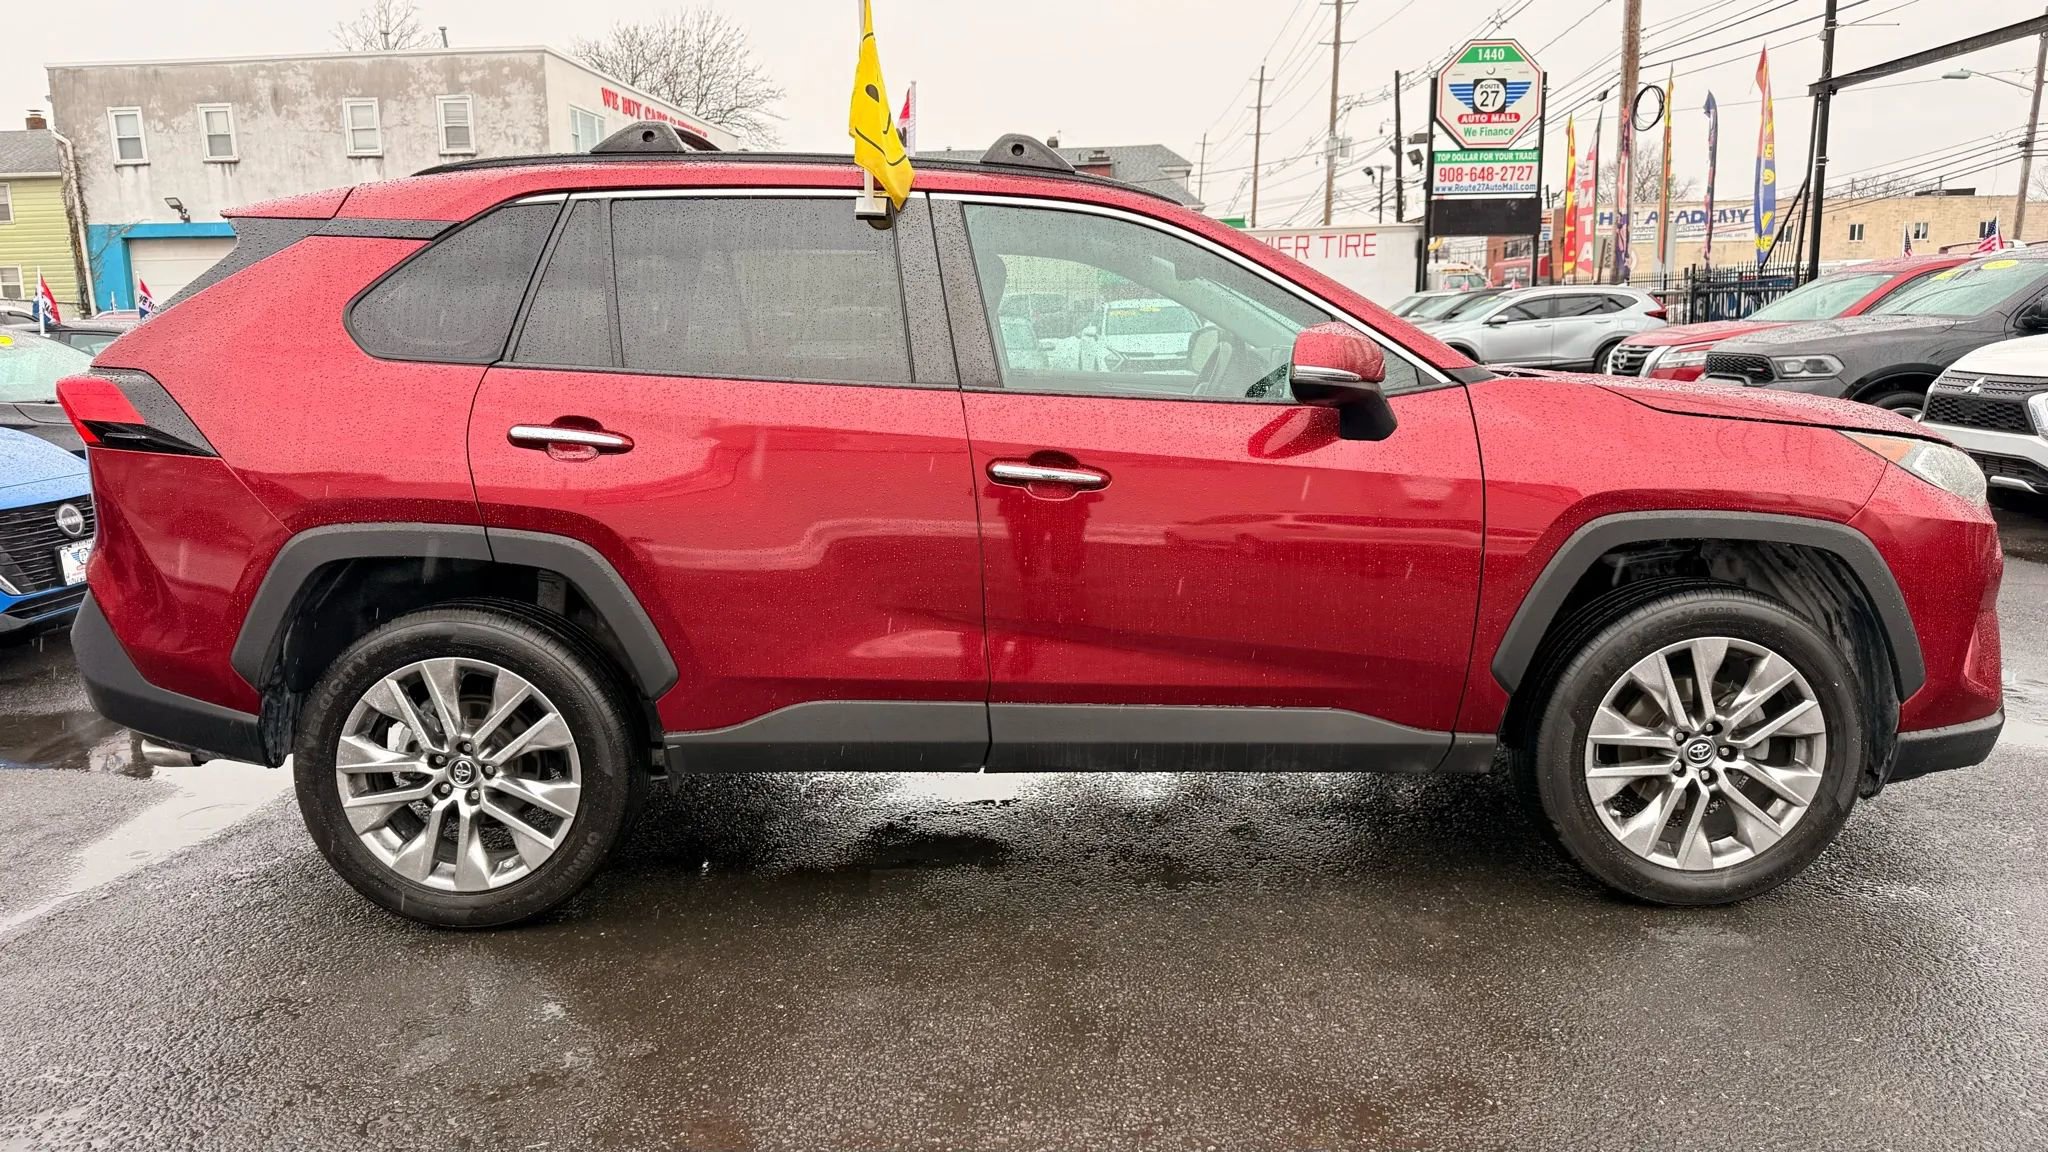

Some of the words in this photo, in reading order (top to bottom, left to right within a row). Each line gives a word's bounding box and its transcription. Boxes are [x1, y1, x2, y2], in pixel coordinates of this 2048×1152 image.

[1478, 48, 1505, 61] 1440
[601, 87, 619, 111] WE
[622, 96, 643, 120] BUY
[1479, 90, 1500, 107] 27
[1460, 114, 1488, 123] AUTO
[1490, 113, 1518, 122] MALL
[1463, 126, 1477, 137] We
[1479, 126, 1514, 136] Finance
[1437, 153, 1451, 162] TOP
[1451, 152, 1479, 161] DOLLAR
[1479, 152, 1494, 161] FOR
[1495, 152, 1514, 161] YOUR
[1515, 151, 1538, 160] TRADE
[1439, 165, 1534, 182] 908-648-2727
[1435, 182, 1536, 192] www.Route27AutoMall.com
[1319, 232, 1377, 259] TIRE
